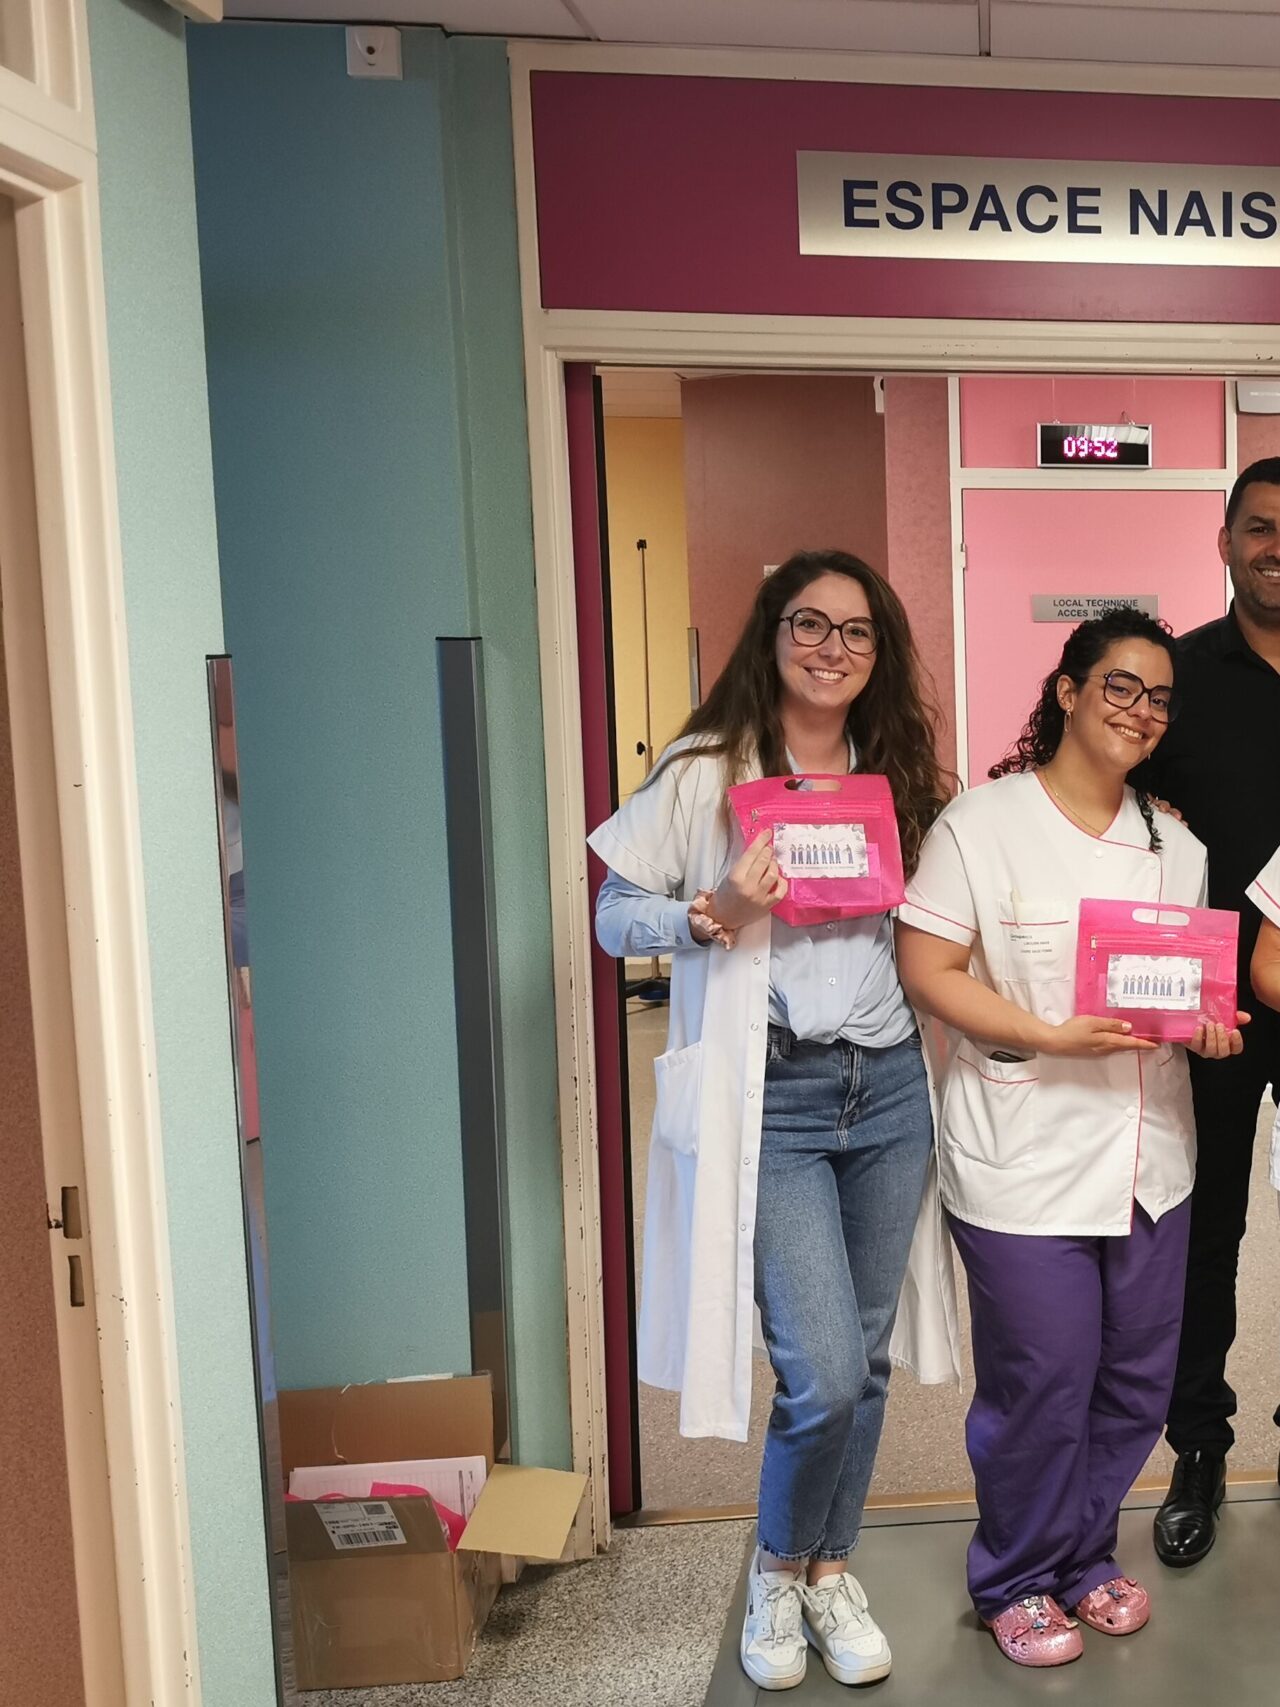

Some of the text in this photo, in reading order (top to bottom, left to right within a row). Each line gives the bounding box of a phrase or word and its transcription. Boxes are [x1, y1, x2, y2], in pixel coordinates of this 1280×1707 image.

[842, 179, 1102, 235] ESPACE
[1063, 437, 1118, 458] 09:52
[1053, 599, 1138, 607] LOCAL TECHNIQUE
[1057, 609, 1089, 617] ACCES
